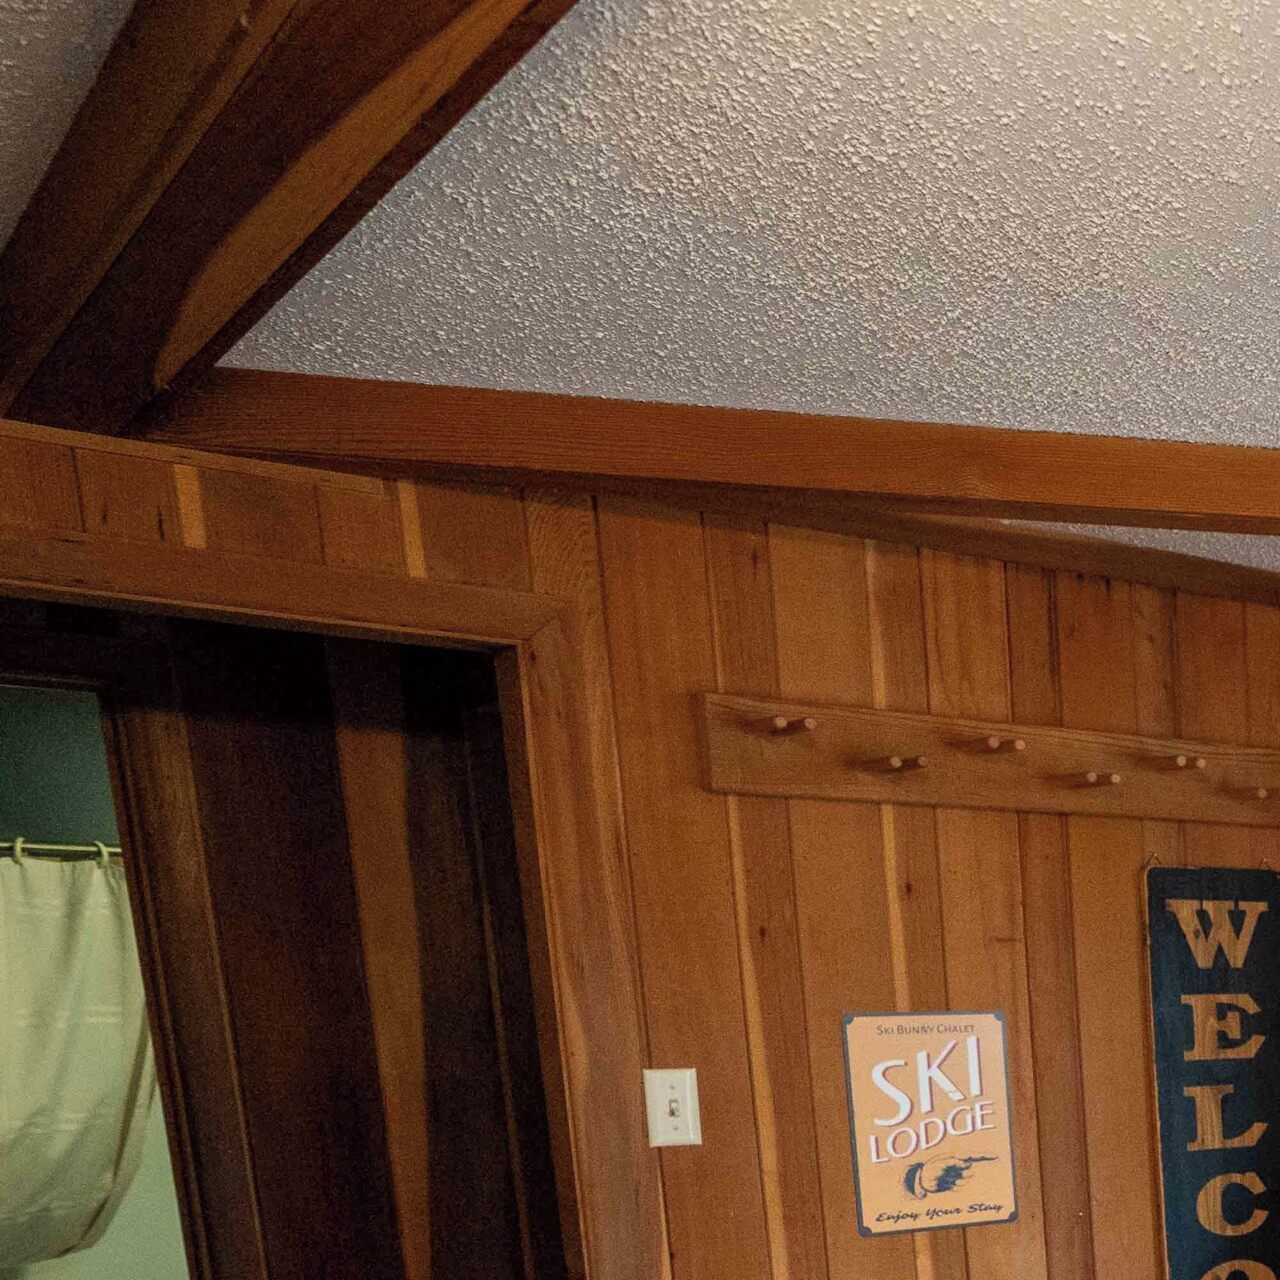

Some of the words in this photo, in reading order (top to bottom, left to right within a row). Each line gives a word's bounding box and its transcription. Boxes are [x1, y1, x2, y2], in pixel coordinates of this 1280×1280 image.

[870, 1034, 983, 1127] SKI
[868, 1100, 996, 1163] LODGE
[875, 1210, 921, 1224] Enjoy
[926, 1206, 963, 1221] Your
[967, 1202, 1005, 1215] Stay
